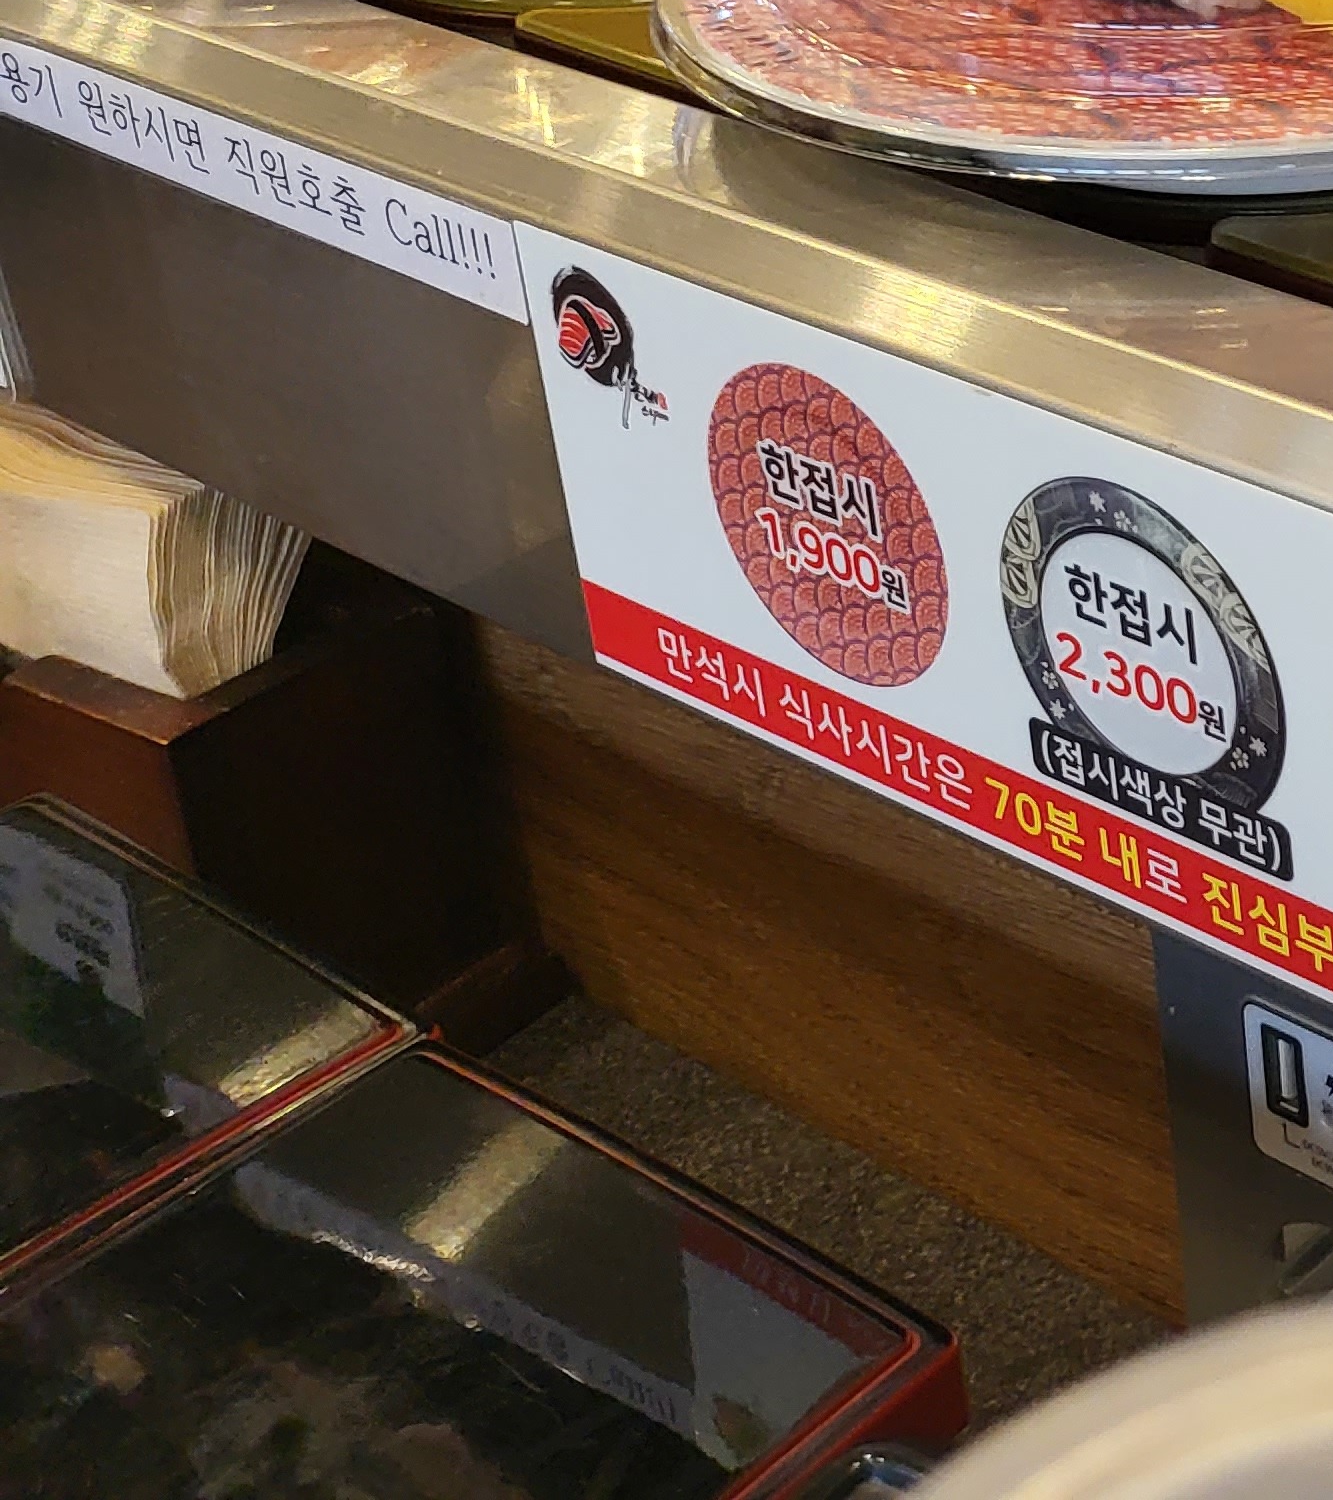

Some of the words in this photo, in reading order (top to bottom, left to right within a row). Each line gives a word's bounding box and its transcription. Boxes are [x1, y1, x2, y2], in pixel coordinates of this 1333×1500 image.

[0, 52, 63, 118] 용기
[78, 80, 210, 175] 원하시면
[224, 136, 366, 237] 직원호출
[385, 198, 497, 280] Call!!!
[759, 443, 879, 537] 한접시
[760, 512, 908, 610] 1,900원
[1063, 563, 1198, 667] 한접시
[1056, 631, 1227, 743] 2,300원
[657, 627, 766, 718] 만석시
[779, 683, 973, 811] 식사시간은
[984, 776, 1085, 862] 70분
[1099, 826, 1188, 904] 내로
[1041, 729, 1187, 829] (접시색상
[1197, 799, 1282, 872] 무관)
